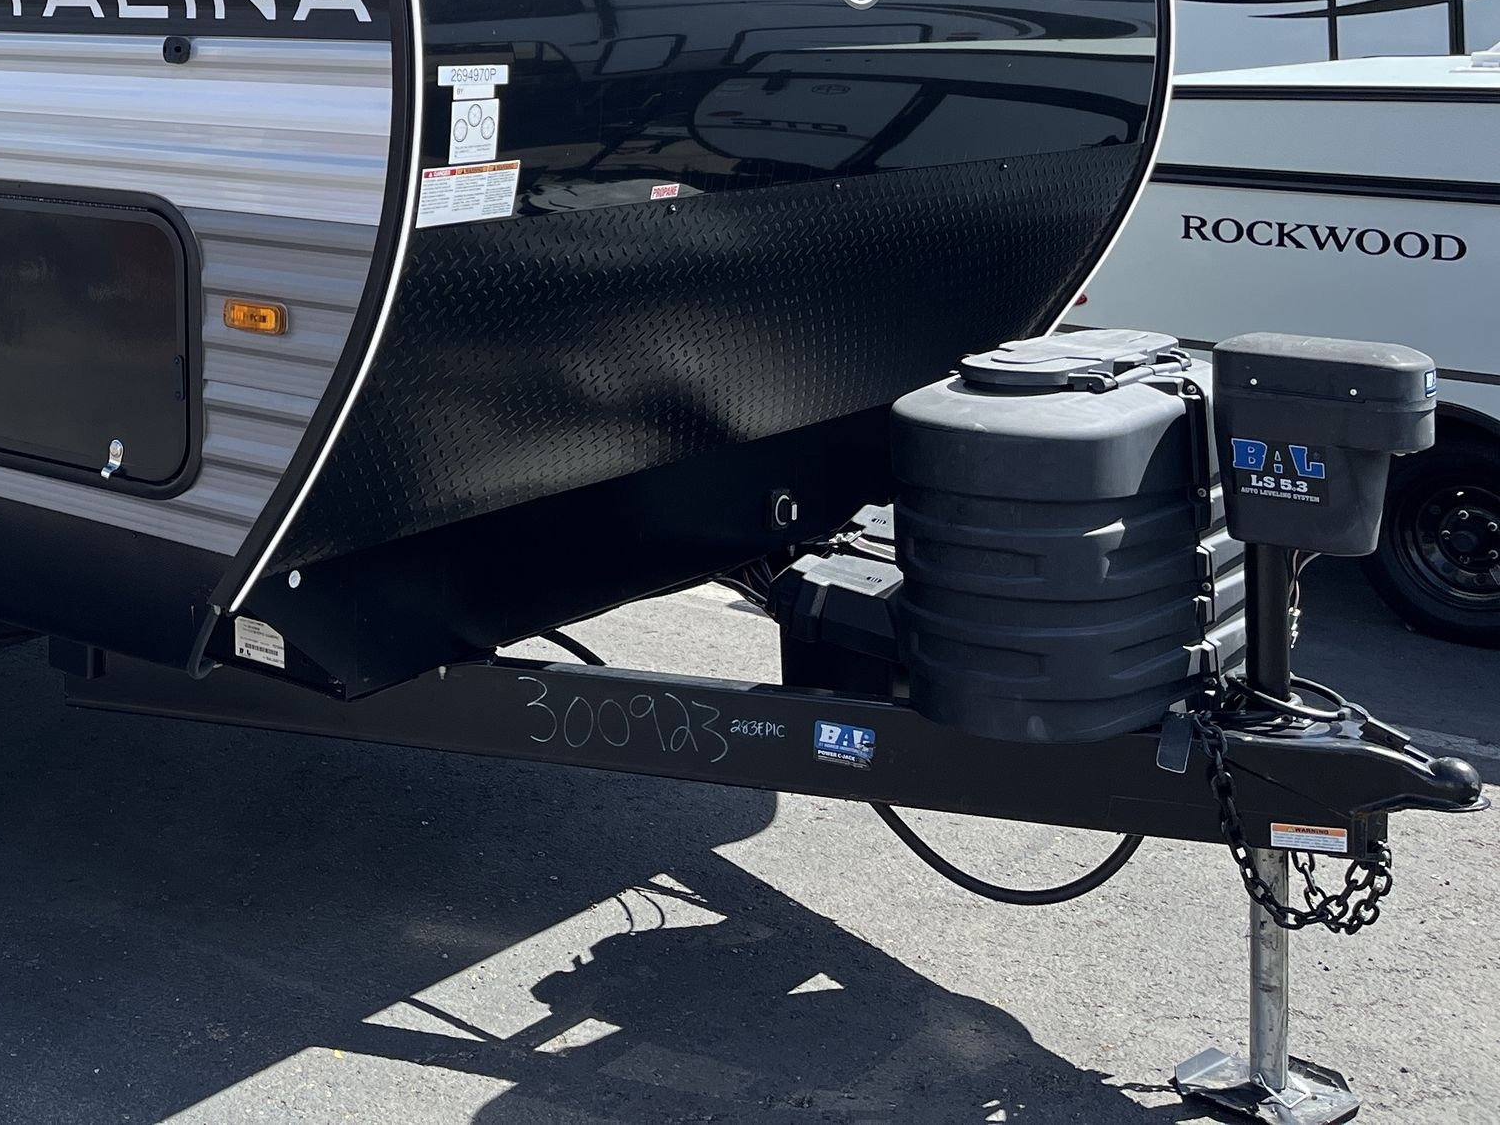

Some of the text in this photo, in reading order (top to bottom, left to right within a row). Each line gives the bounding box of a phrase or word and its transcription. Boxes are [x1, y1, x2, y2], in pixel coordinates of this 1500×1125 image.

[450, 67, 497, 83] 2694970P
[1180, 214, 1467, 262] ROCKWOOD
[1231, 438, 1326, 480] BAL
[1250, 474, 1309, 493] LS 5.3
[1240, 486, 1259, 495] AUTO
[1293, 493, 1320, 503] SYSTEM
[517, 676, 786, 763] 300923 283EPIC
[817, 749, 837, 757] POWER
[1294, 827, 1329, 835] WARNING
